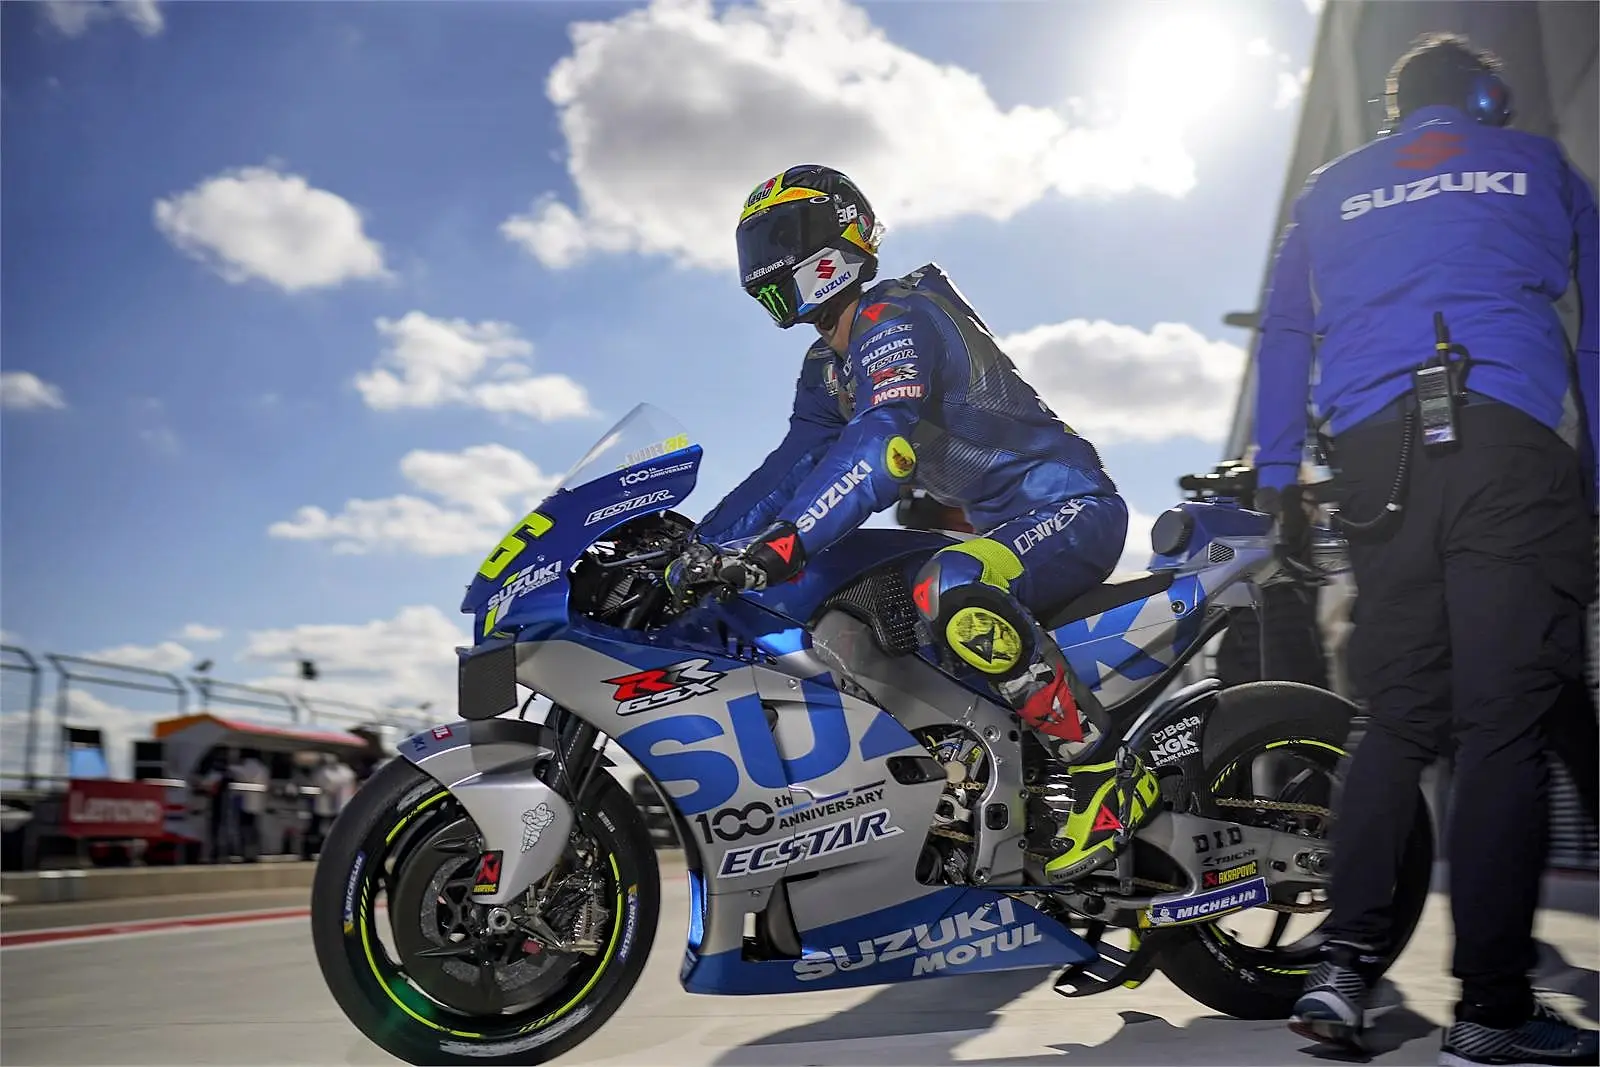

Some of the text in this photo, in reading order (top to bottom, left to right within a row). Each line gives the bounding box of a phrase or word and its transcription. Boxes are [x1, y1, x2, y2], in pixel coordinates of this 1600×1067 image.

[837, 204, 858, 223] 36
[1341, 171, 1527, 221] SUZUKI
[814, 271, 852, 299] SUZUKI
[861, 338, 914, 367] SUZUKI
[867, 348, 919, 377] ECSTAR
[874, 386, 922, 405] MOTUL
[650, 464, 693, 478] ANNIVERSARY
[583, 489, 676, 526] ECSTAR
[795, 460, 873, 533] SUZUKI
[1012, 499, 1087, 555] DAINESE
[487, 560, 562, 611] SUZUKI
[1164, 716, 1200, 737] Beta
[1150, 731, 1197, 762] NGK
[1155, 746, 1200, 767] SPARK PLUGS
[778, 789, 886, 830] ANNIVERSARY
[716, 808, 905, 879] ECSTAR
[345, 855, 362, 911] MICHELIN
[1176, 889, 1257, 919] MICHELIN
[620, 904, 637, 959] MICHELIN
[793, 897, 1016, 982] SUZUKI
[912, 923, 1043, 977] MOTUL
